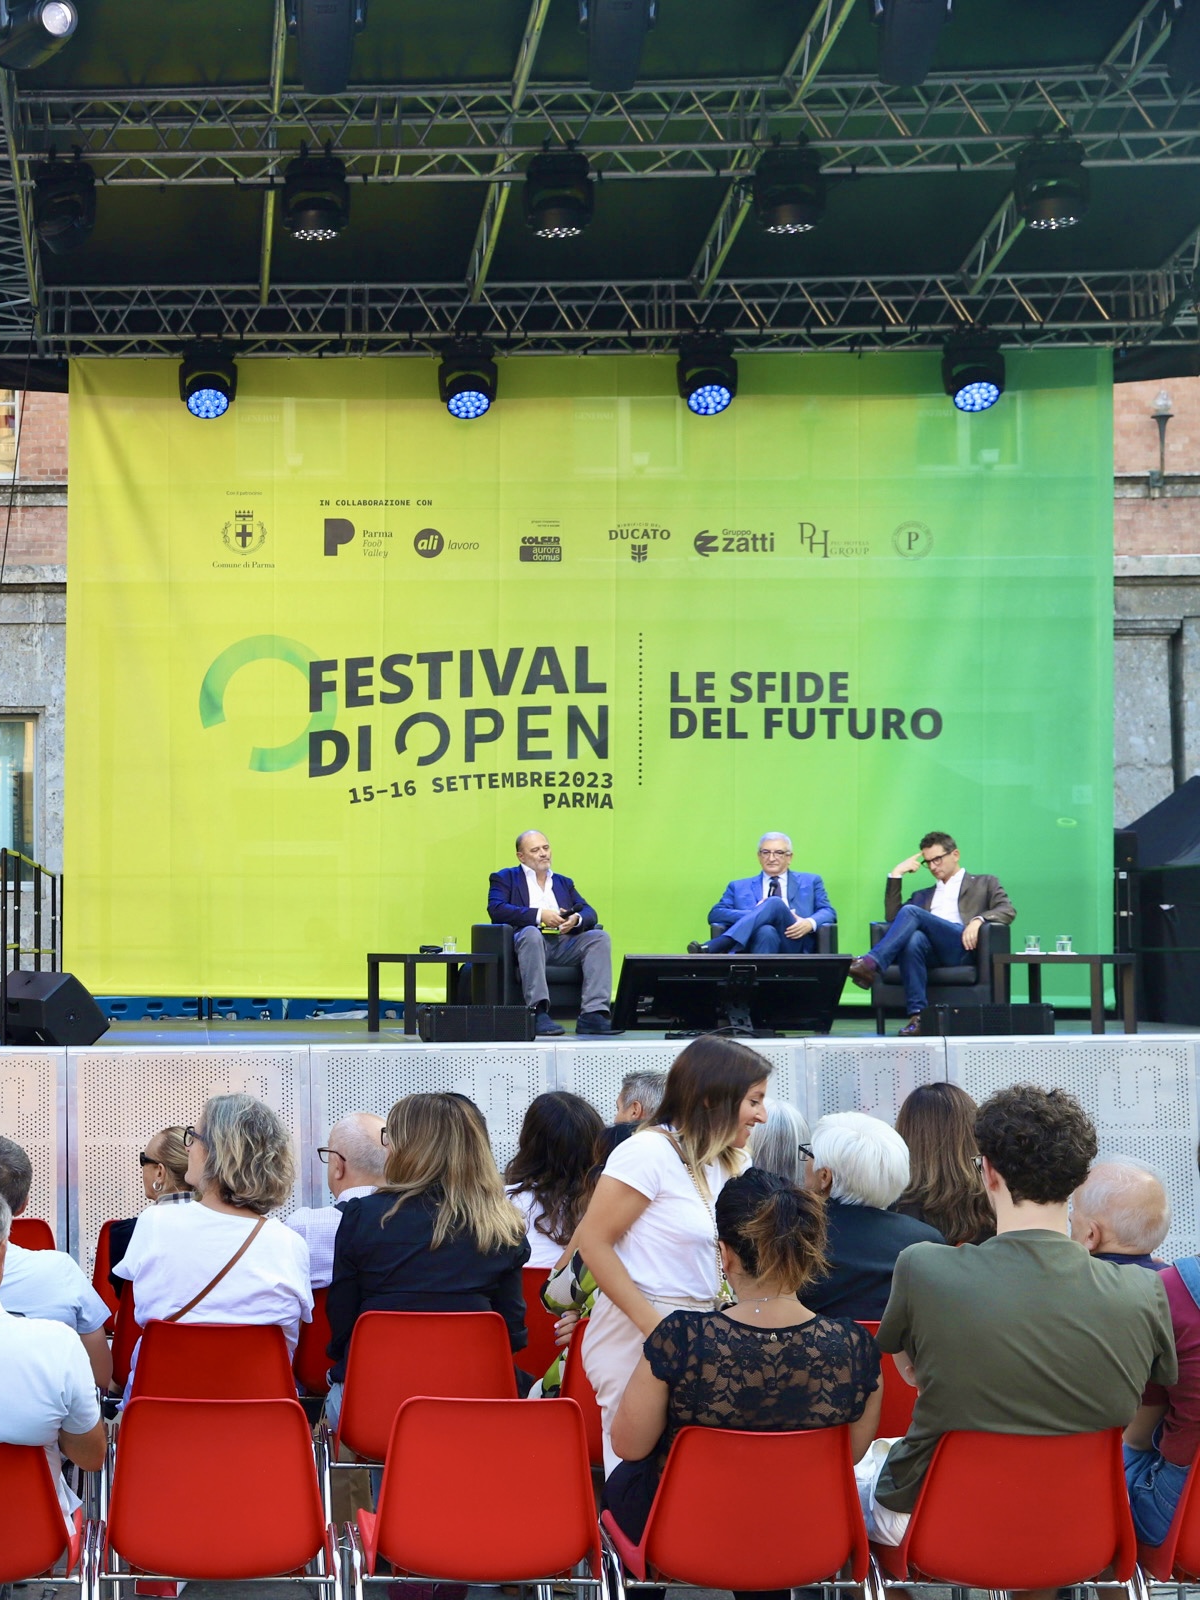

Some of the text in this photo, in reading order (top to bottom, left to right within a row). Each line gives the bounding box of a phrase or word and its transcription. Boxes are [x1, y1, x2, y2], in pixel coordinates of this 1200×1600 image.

[335, 499, 411, 507] COLLABORAZIONE
[363, 530, 393, 538] Parma
[608, 528, 671, 541] DUCATO
[722, 528, 752, 536] Gruppo
[363, 539, 383, 548] Food
[417, 535, 439, 550] ali
[447, 539, 480, 550] lavoro
[722, 532, 775, 553] zatti
[362, 549, 389, 559] Valley
[532, 546, 560, 554] aurora
[829, 547, 870, 557] GROUP
[532, 553, 560, 561] domus
[308, 645, 608, 712] FESTIVAL
[670, 671, 849, 704] LE SFIDE
[669, 707, 943, 741] DEL FUTURO
[308, 705, 609, 779] DI OPEN
[348, 780, 417, 805] 15-16
[543, 793, 614, 810] PARMA
